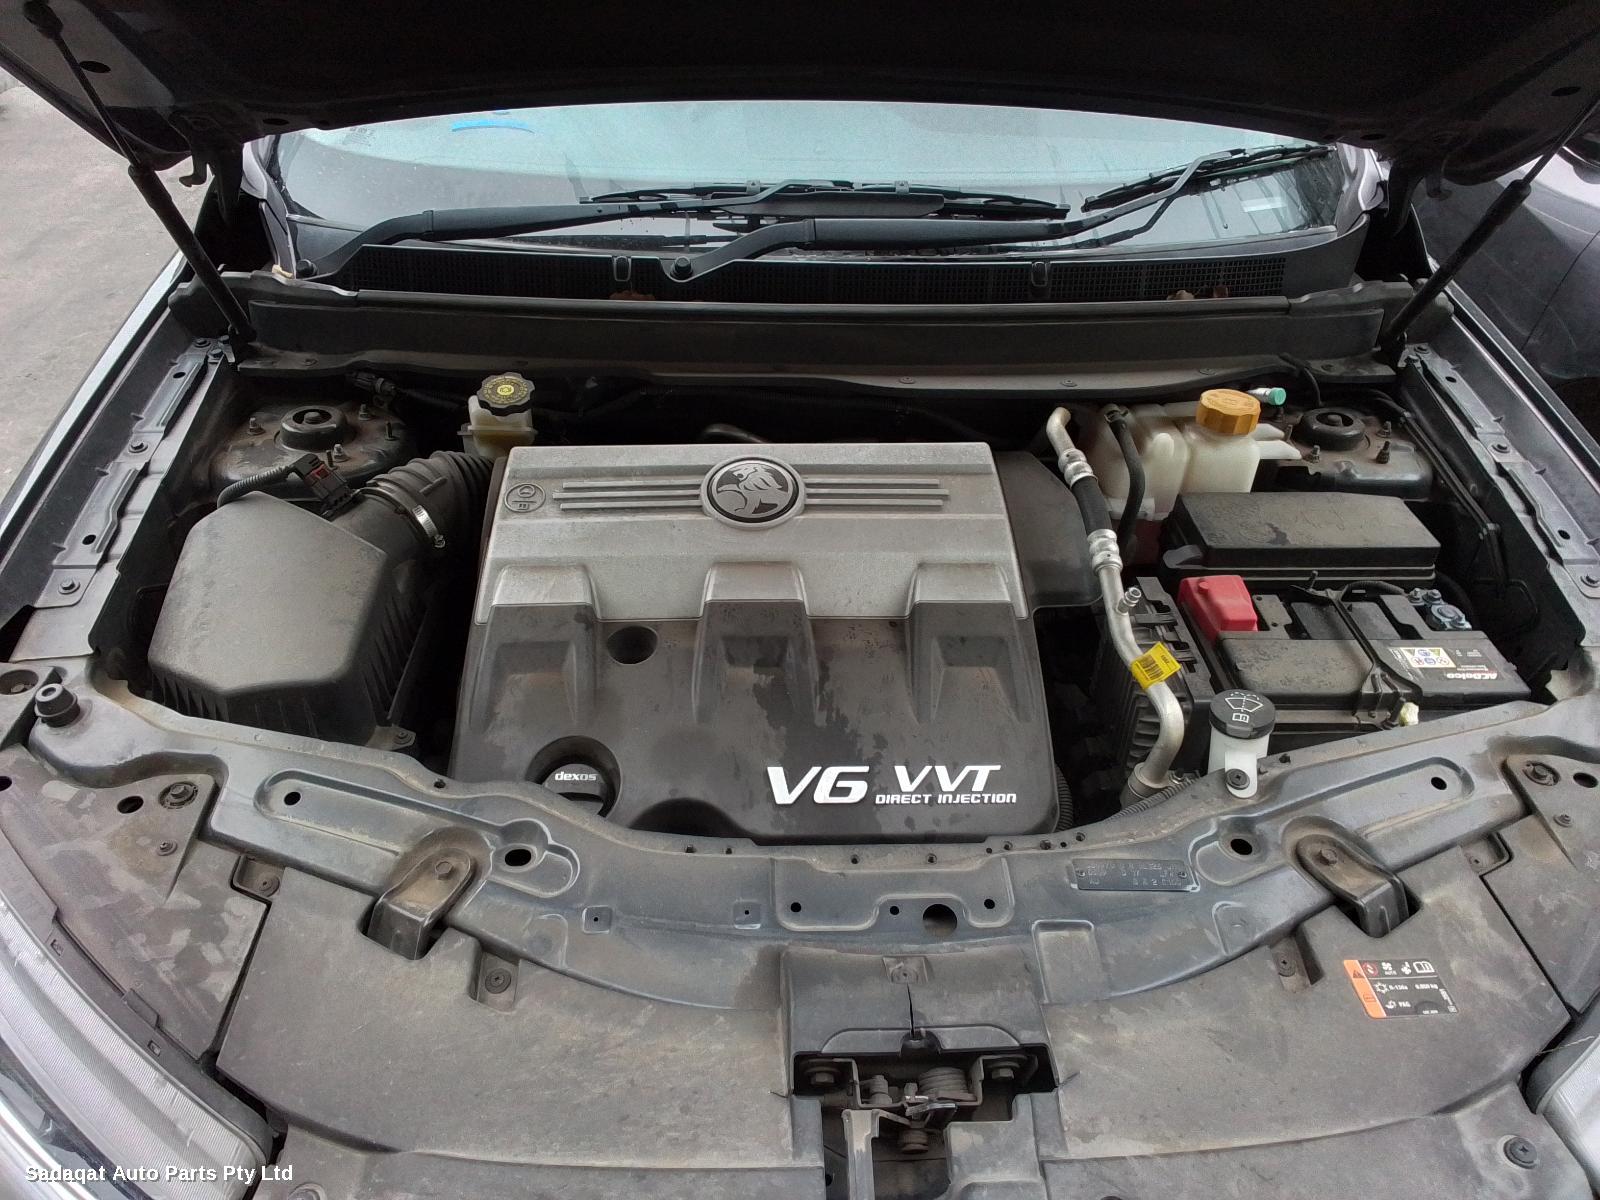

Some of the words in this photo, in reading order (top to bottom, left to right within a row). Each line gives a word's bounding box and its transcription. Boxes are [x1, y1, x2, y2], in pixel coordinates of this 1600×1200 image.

[554, 771, 599, 781] dexos
[767, 766, 870, 804] V6
[894, 765, 1001, 792] VVT
[875, 793, 930, 804] DIRECT
[937, 793, 1016, 804] INJECTION
